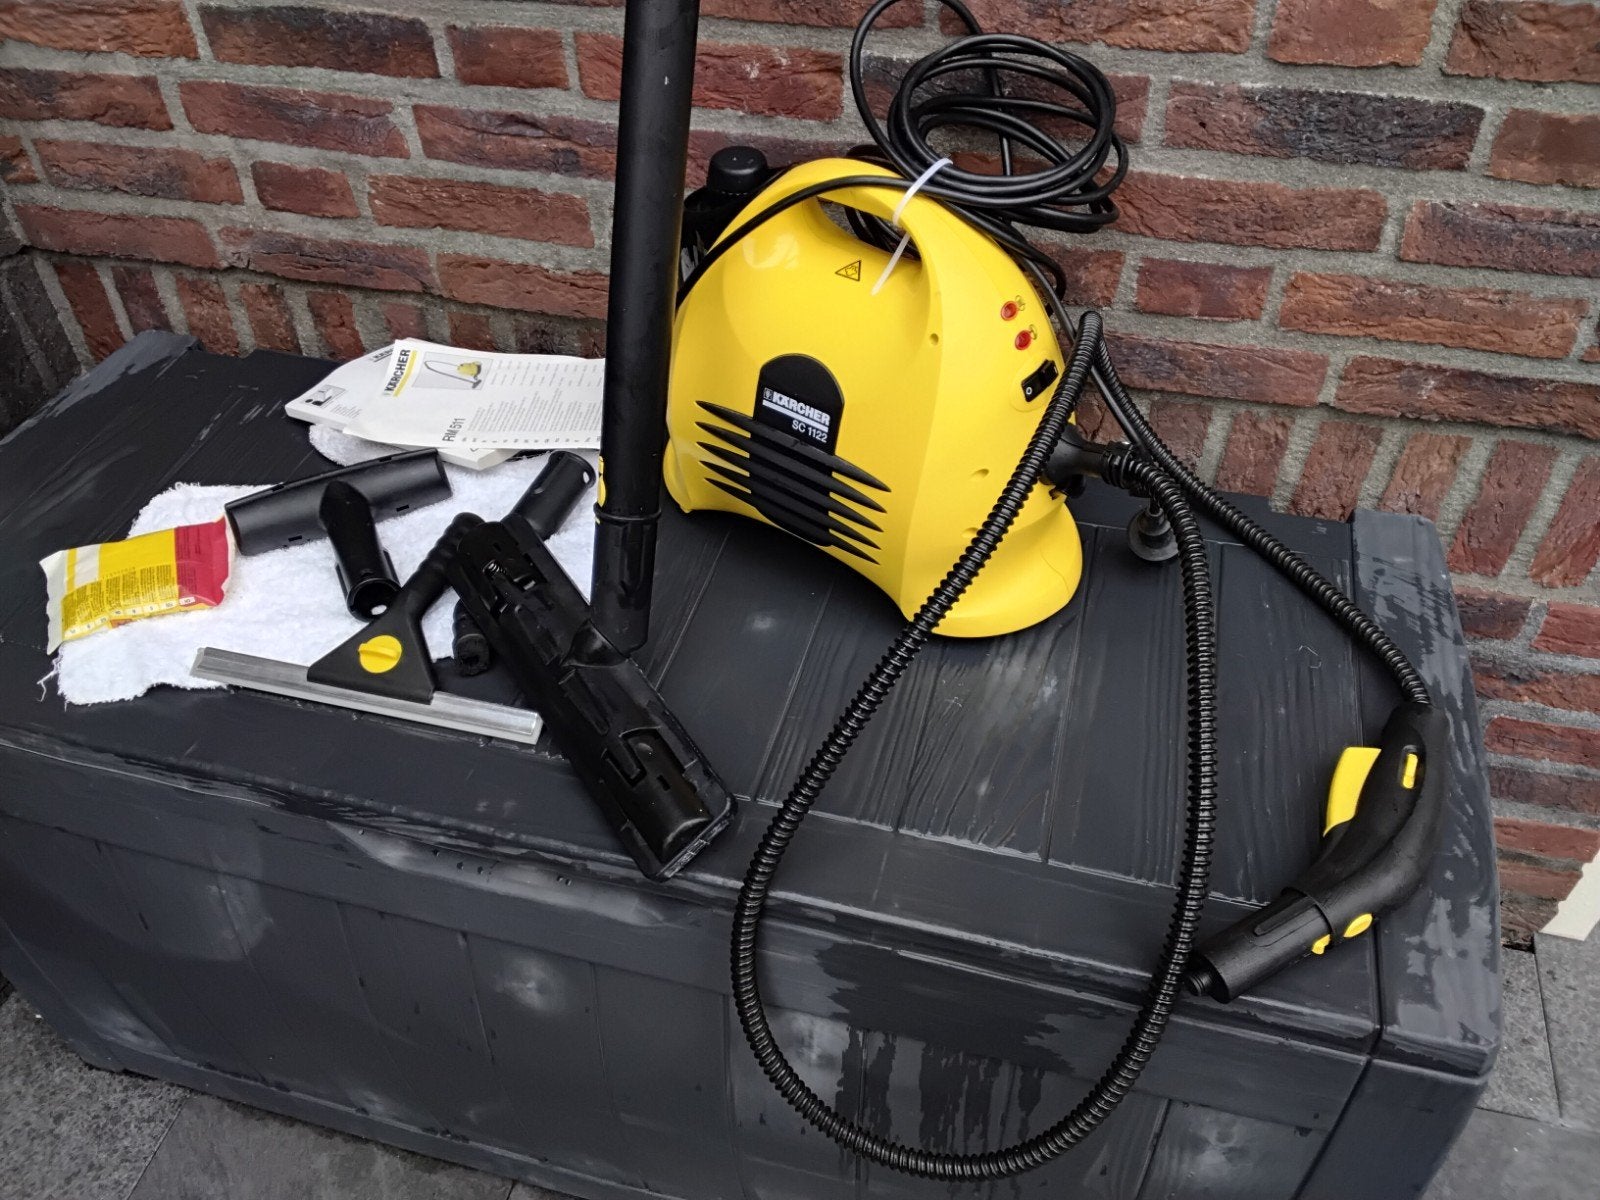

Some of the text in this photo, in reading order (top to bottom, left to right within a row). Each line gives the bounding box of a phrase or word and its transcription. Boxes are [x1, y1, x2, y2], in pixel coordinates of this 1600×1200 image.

[442, 418, 466, 442] RM 511
[791, 419, 828, 443] SC 1122
